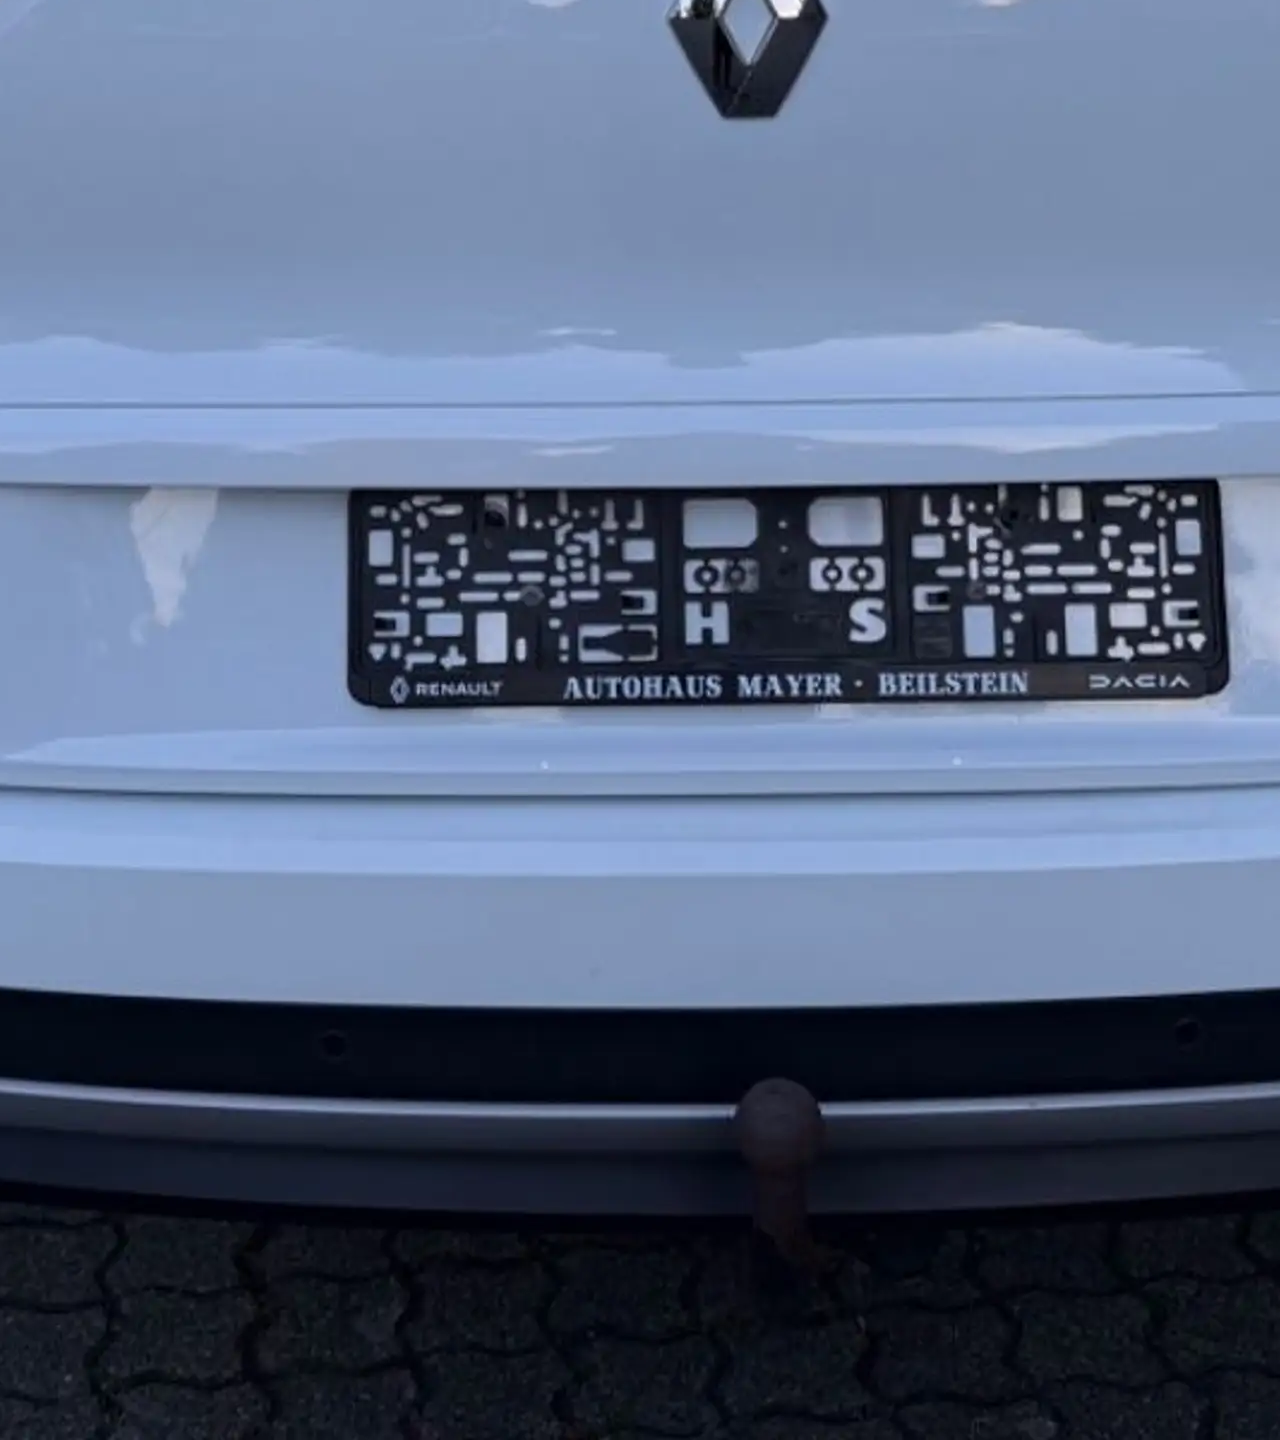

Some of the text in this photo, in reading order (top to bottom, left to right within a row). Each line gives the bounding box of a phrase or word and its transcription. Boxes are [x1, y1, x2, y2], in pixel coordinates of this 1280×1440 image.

[684, 599, 730, 646] H
[848, 596, 887, 643] S
[416, 680, 505, 698] RENAULT
[563, 670, 1029, 700] AUTOHAUS MAYER BEILSTEIN
[1088, 672, 1190, 690] DACIA
